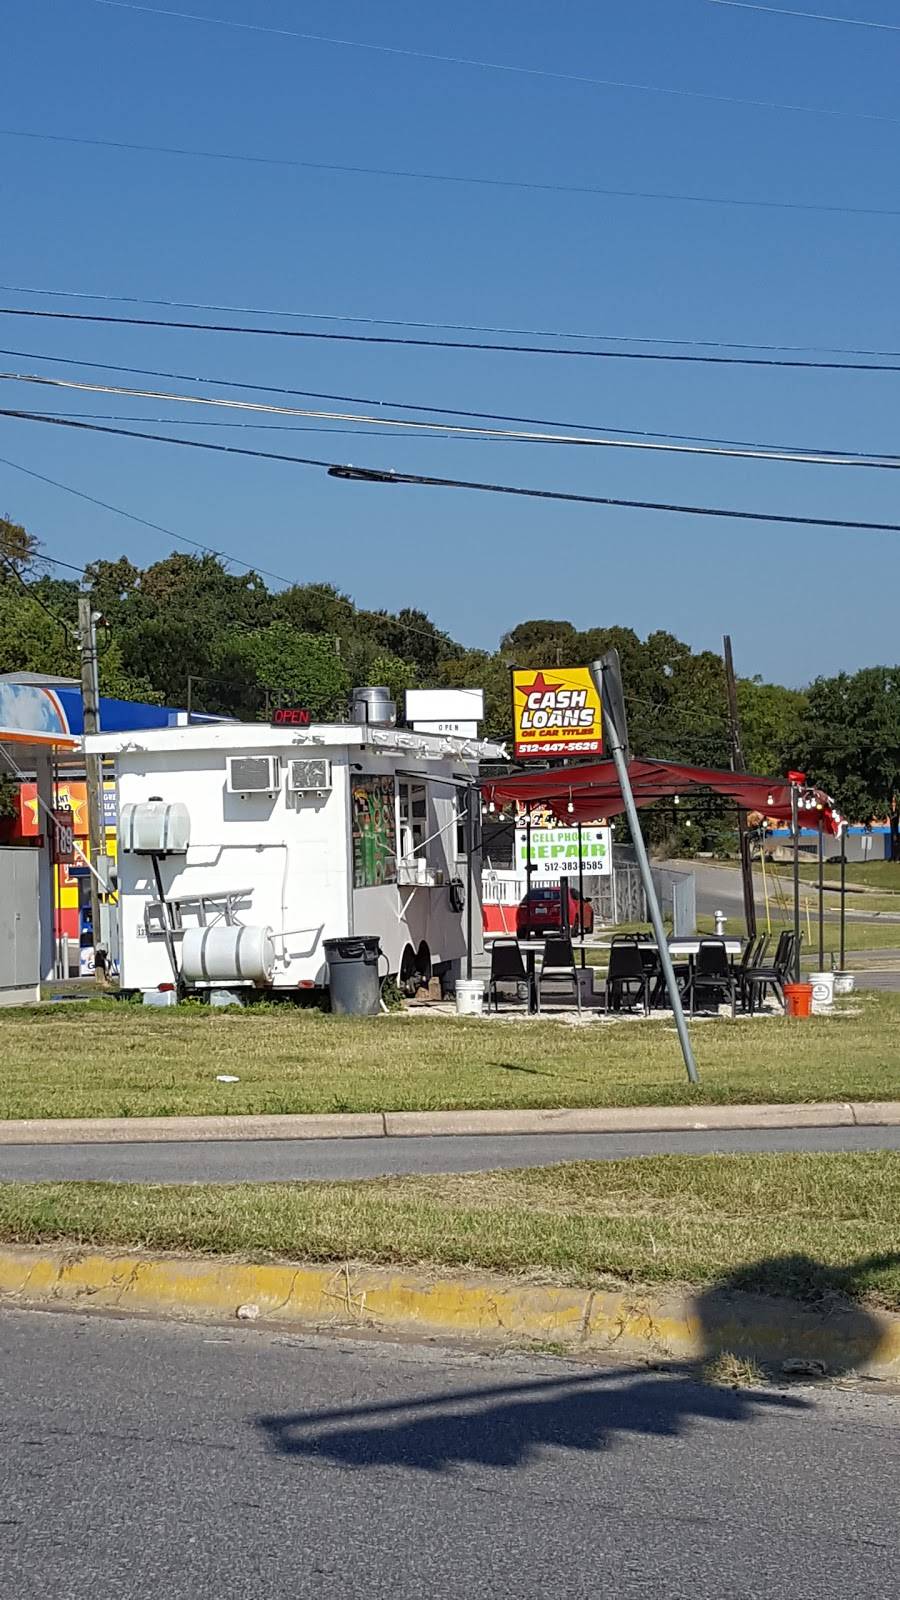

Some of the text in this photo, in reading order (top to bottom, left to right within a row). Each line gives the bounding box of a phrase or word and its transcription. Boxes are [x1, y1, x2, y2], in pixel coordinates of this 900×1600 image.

[527, 690, 587, 709] CASH
[274, 710, 309, 724] OPEN
[521, 709, 594, 728] LOANS
[438, 723, 460, 731] OPEN
[539, 729, 559, 737] CAR
[562, 728, 594, 736] TITLES
[518, 741, 599, 753] 512-447-5626
[532, 833, 555, 843] CELL
[520, 844, 606, 859] REPAIR
[544, 861, 603, 871] 512-3838585
